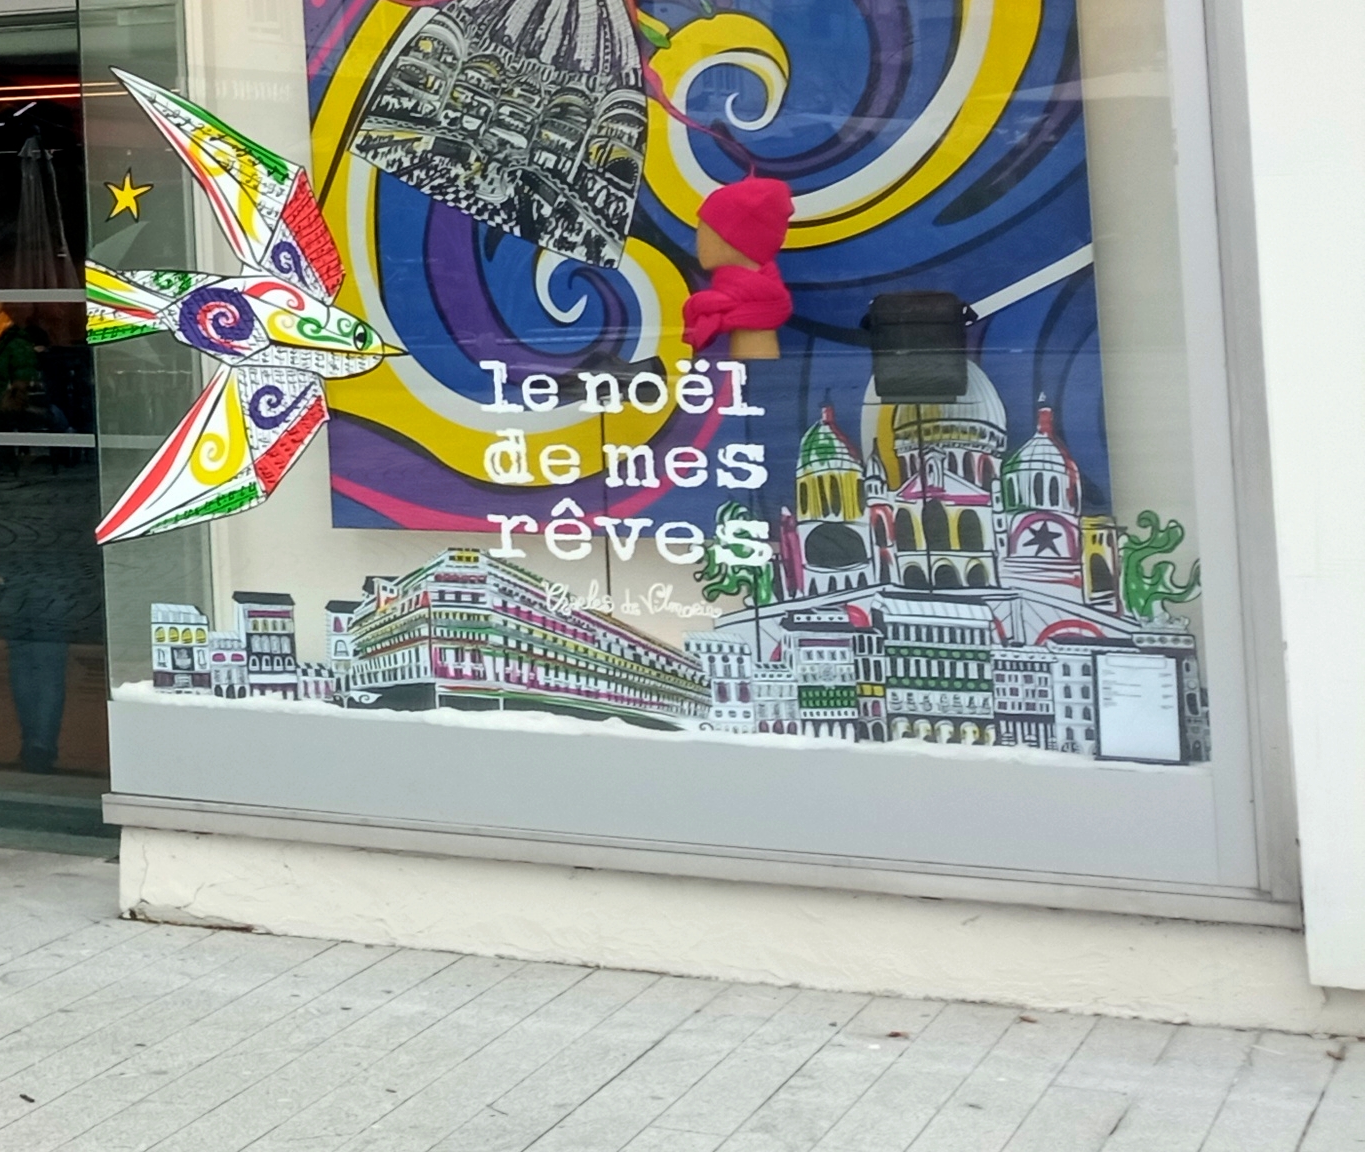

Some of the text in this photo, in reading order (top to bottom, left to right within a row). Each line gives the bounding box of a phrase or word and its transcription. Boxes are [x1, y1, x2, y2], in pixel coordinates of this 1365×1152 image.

[479, 359, 765, 416] le noël
[484, 428, 768, 489] de mes
[487, 498, 774, 566] rêves
